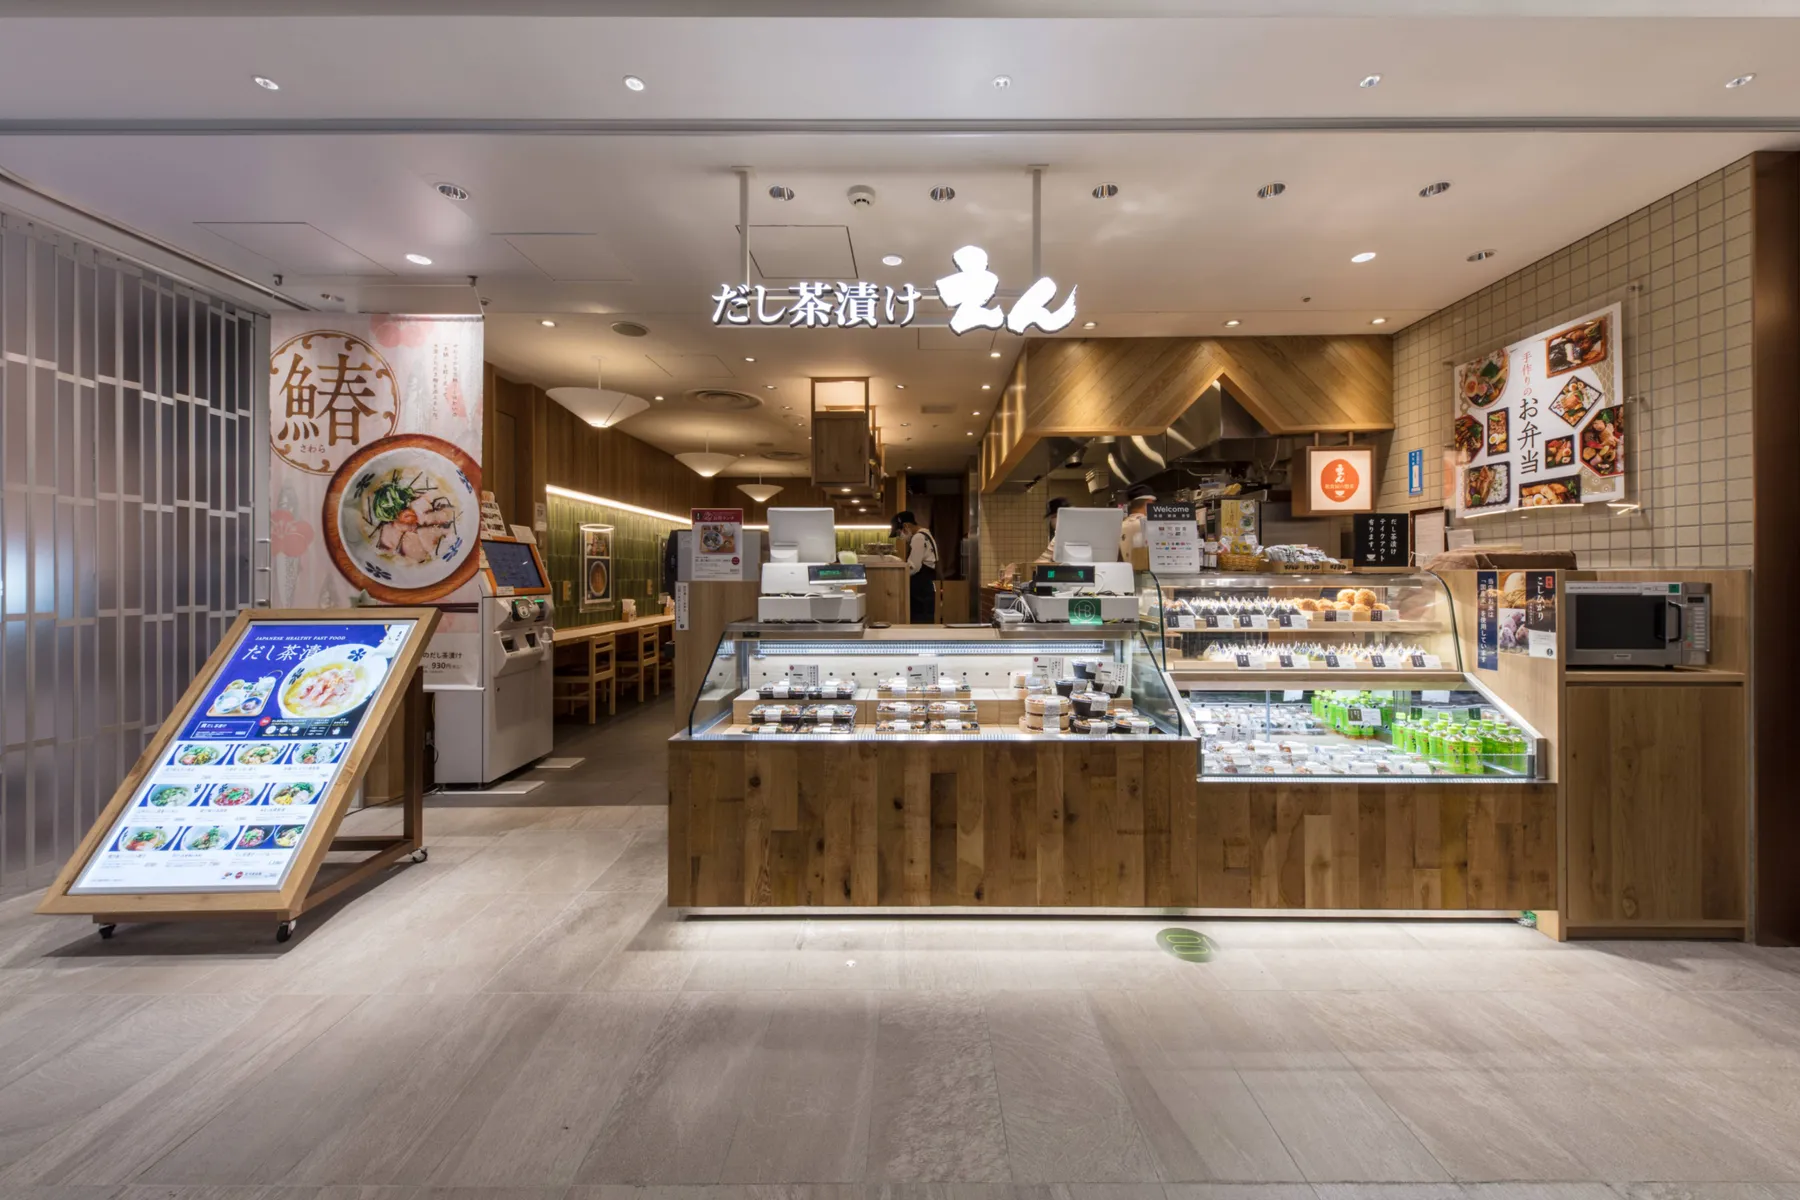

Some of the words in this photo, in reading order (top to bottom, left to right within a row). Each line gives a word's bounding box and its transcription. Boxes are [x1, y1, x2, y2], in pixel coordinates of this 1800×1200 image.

[711, 281, 922, 329] だし茶漬け
[935, 244, 1078, 336] えん
[277, 352, 379, 447] 鰆
[300, 444, 326, 454] さわら
[1152, 505, 1190, 513] Welcome
[1379, 518, 1387, 562] テイクアウト
[1390, 518, 1398, 555] だし茶漬け
